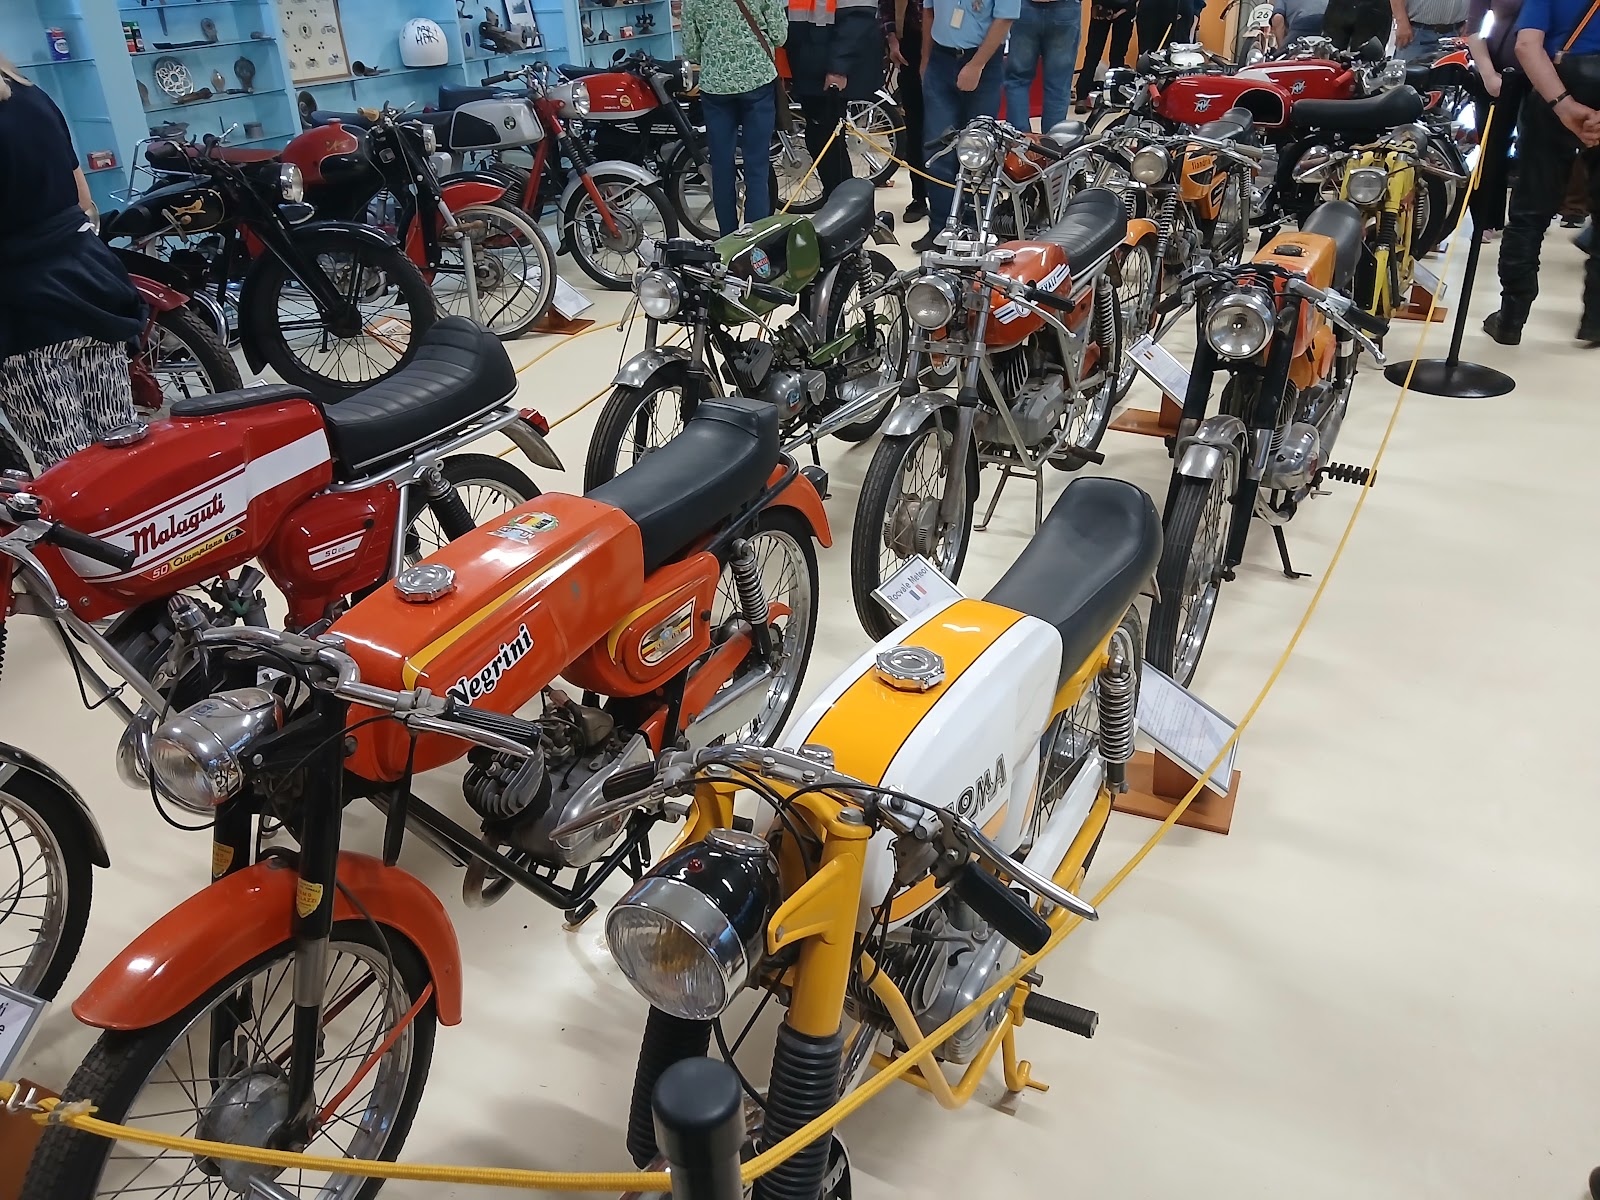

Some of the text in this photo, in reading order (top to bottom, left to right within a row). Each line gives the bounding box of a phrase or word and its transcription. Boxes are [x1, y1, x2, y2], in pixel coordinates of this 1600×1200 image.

[1256, 11, 1269, 19] 26
[125, 492, 226, 559] Malaguti
[152, 564, 169, 579] 50
[887, 567, 928, 603] Rocvale Meteor
[446, 624, 533, 705] Negrini
